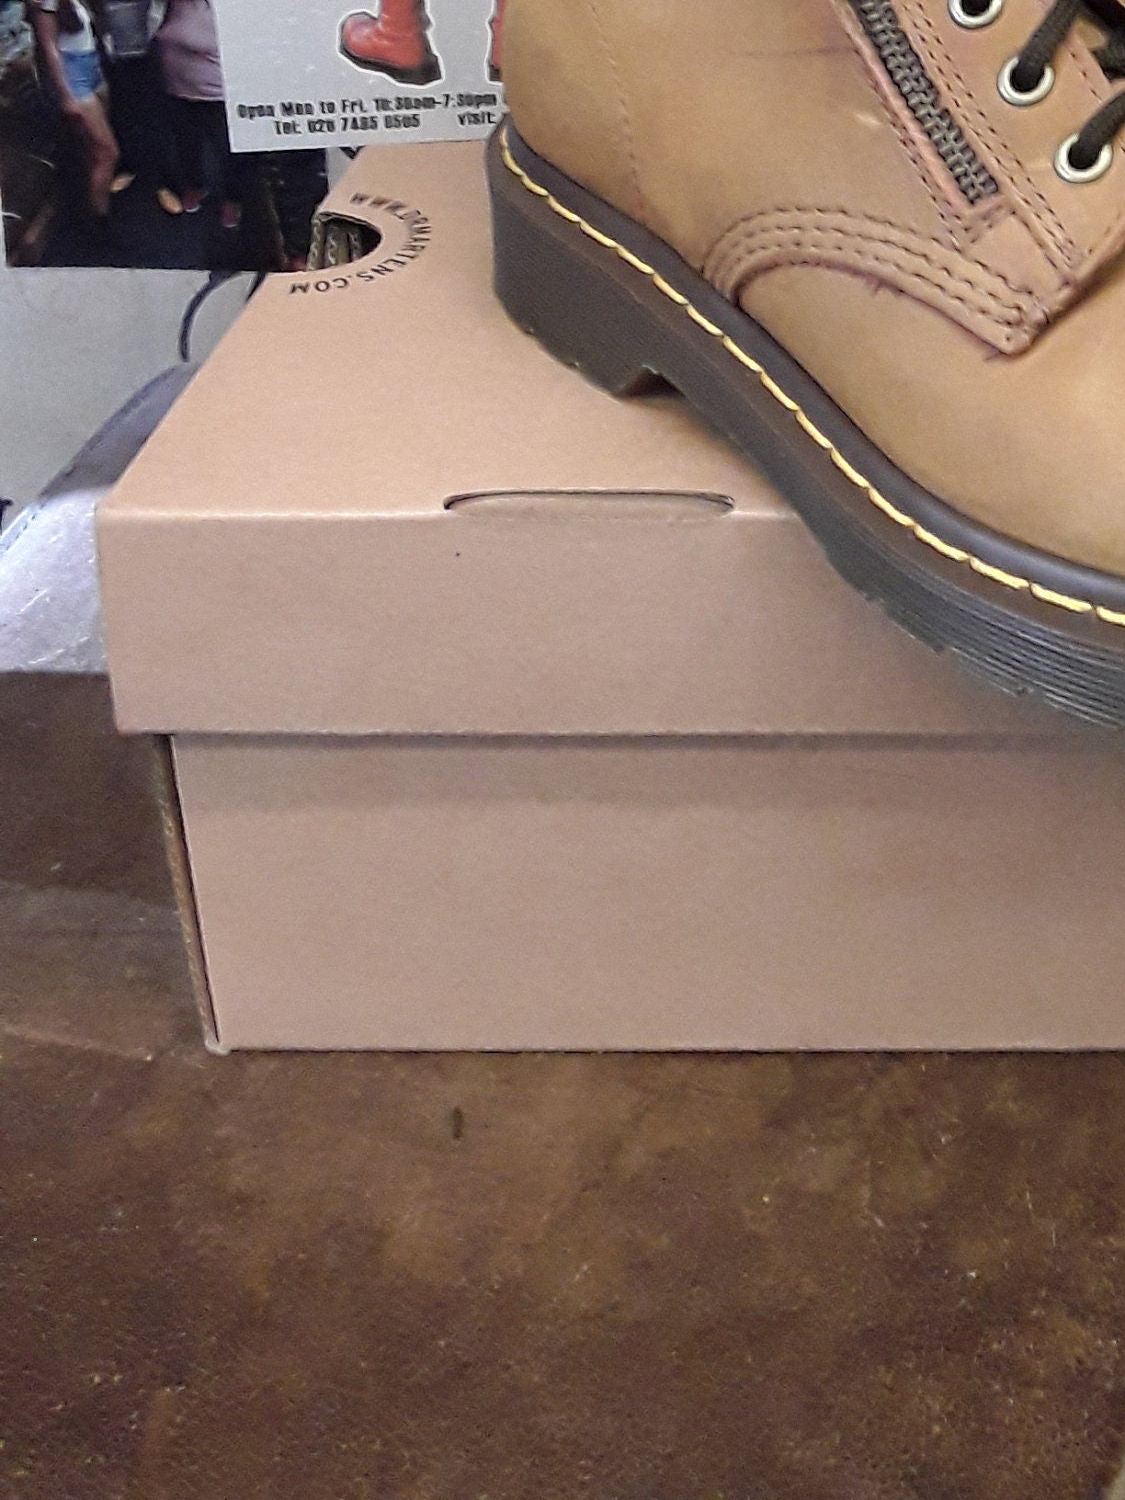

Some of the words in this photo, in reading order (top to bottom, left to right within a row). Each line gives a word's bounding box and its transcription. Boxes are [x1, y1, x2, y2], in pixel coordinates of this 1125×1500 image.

[236, 104, 275, 119] Open
[282, 102, 313, 116] Mon
[319, 101, 335, 114] to
[307, 118, 335, 133] 020
